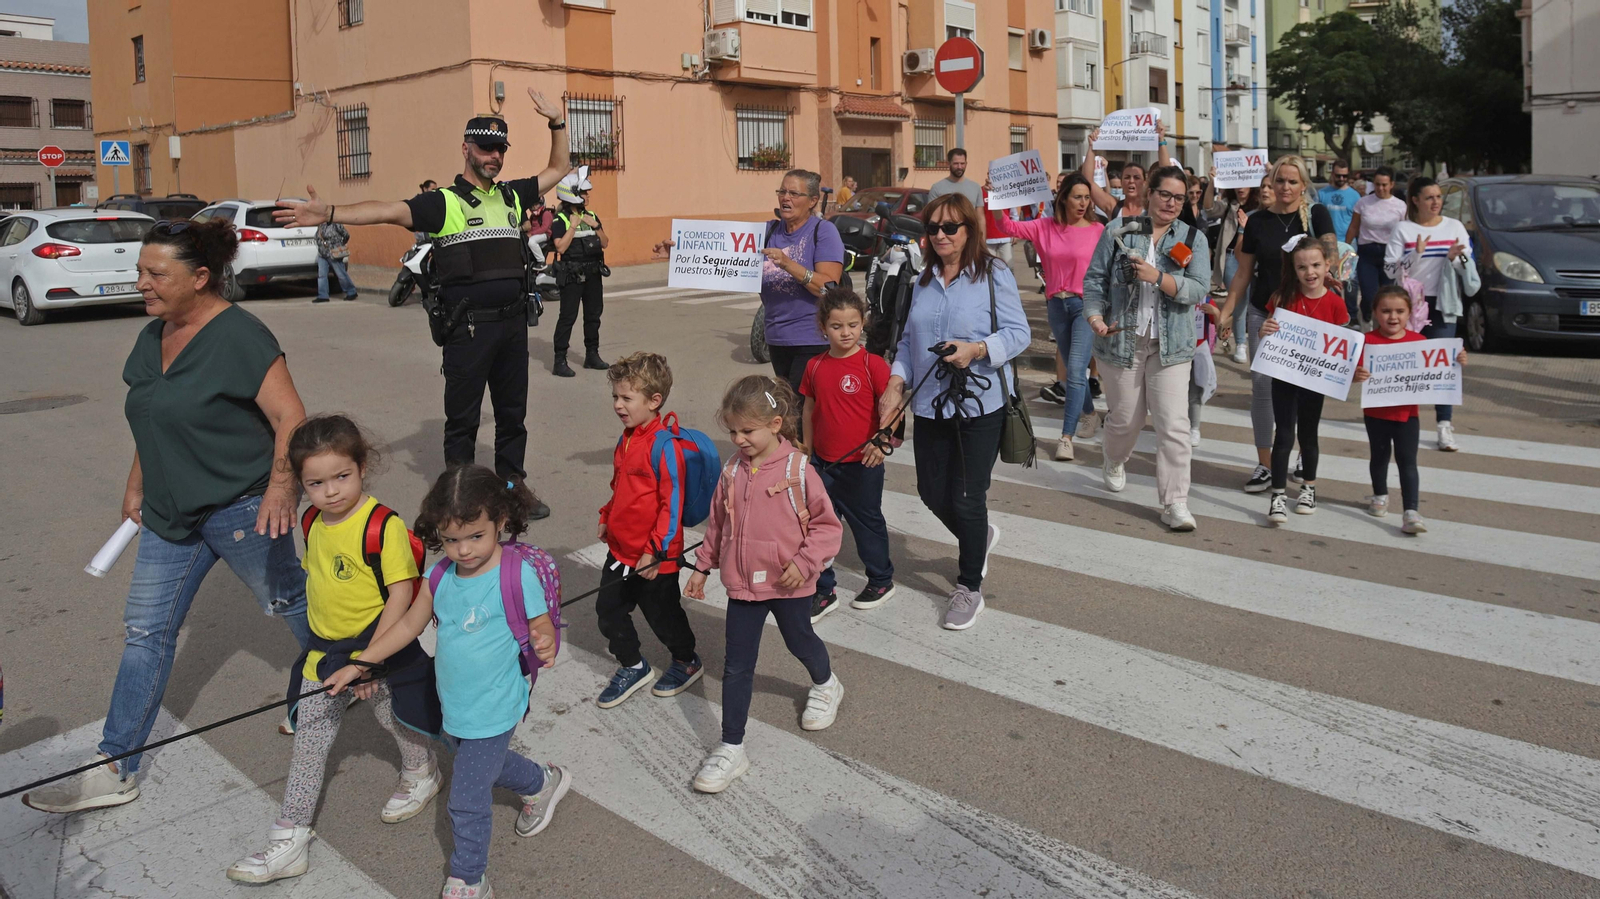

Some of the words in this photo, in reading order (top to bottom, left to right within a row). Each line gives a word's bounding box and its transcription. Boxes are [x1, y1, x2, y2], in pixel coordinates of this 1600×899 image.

[1020, 158, 1042, 174] YA!
[991, 169, 1022, 182] INFANTIL
[1009, 177, 1039, 190] Seguridad
[992, 191, 1018, 200] nuestros
[684, 231, 725, 240] COMEDOR
[683, 240, 727, 251] INFANTIL
[730, 232, 761, 253] YA!
[675, 254, 691, 264] Por
[692, 254, 700, 263] la
[702, 255, 750, 267] Seguridad
[751, 258, 759, 267] de
[675, 266, 712, 275] nuestros
[714, 267, 738, 278] hij@s
[106, 285, 125, 293] 2834
[1278, 320, 1318, 338] COMEDOR
[1275, 330, 1317, 351] INFANTIL
[1323, 332, 1358, 362] YA!
[1263, 340, 1278, 352] Por
[1280, 344, 1288, 355] la
[1288, 349, 1338, 371] Seguridad
[1338, 365, 1350, 375] de
[1377, 352, 1416, 363] COMEDOR
[1421, 348, 1456, 368] YA!
[1260, 352, 1297, 369] nuestros
[1297, 362, 1323, 377] hij@s
[1375, 360, 1418, 373] INFANTIL
[1368, 377, 1383, 386] Por
[1394, 371, 1443, 385] Seguridad
[1444, 371, 1456, 380] de
[1367, 385, 1404, 395] nuestros
[1405, 383, 1430, 394] hij@s
